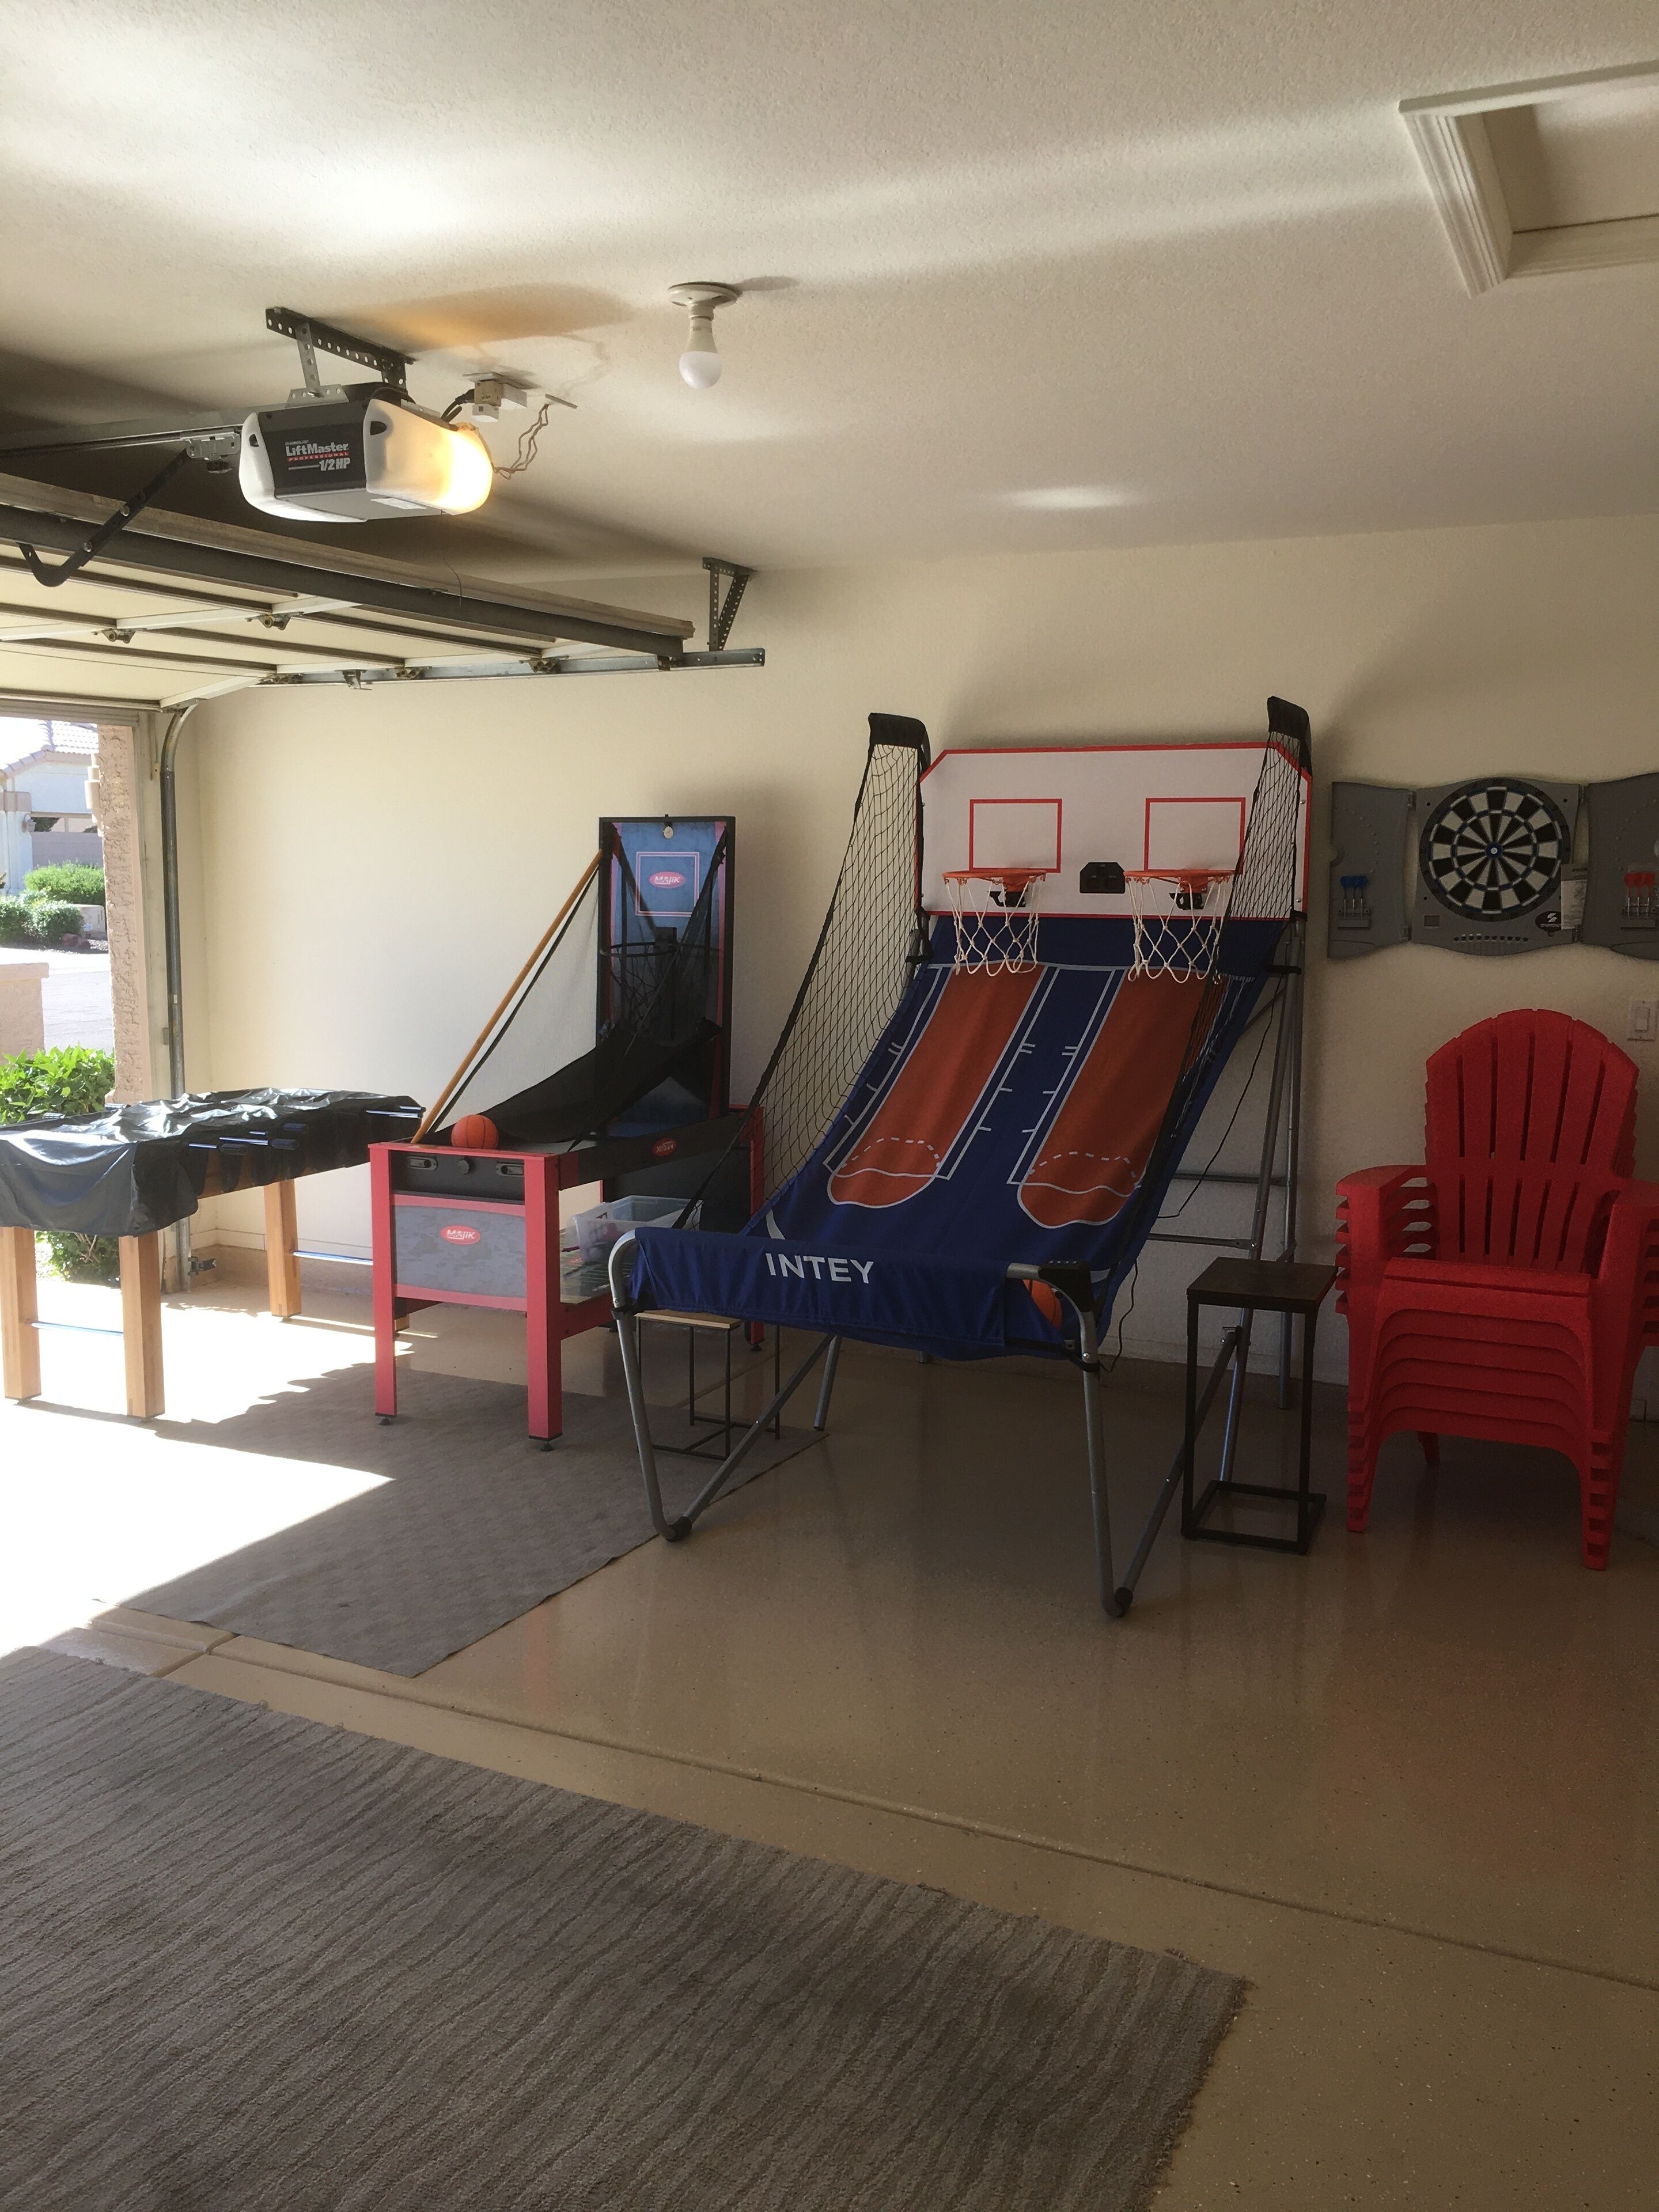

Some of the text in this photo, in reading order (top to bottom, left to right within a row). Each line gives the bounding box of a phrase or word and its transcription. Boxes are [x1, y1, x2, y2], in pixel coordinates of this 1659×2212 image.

[285, 442, 349, 457] LiftMaster
[289, 452, 349, 461] PROFESSIONAL
[446, 1229, 475, 1240] MAJIK
[766, 1253, 874, 1284] INTEY
